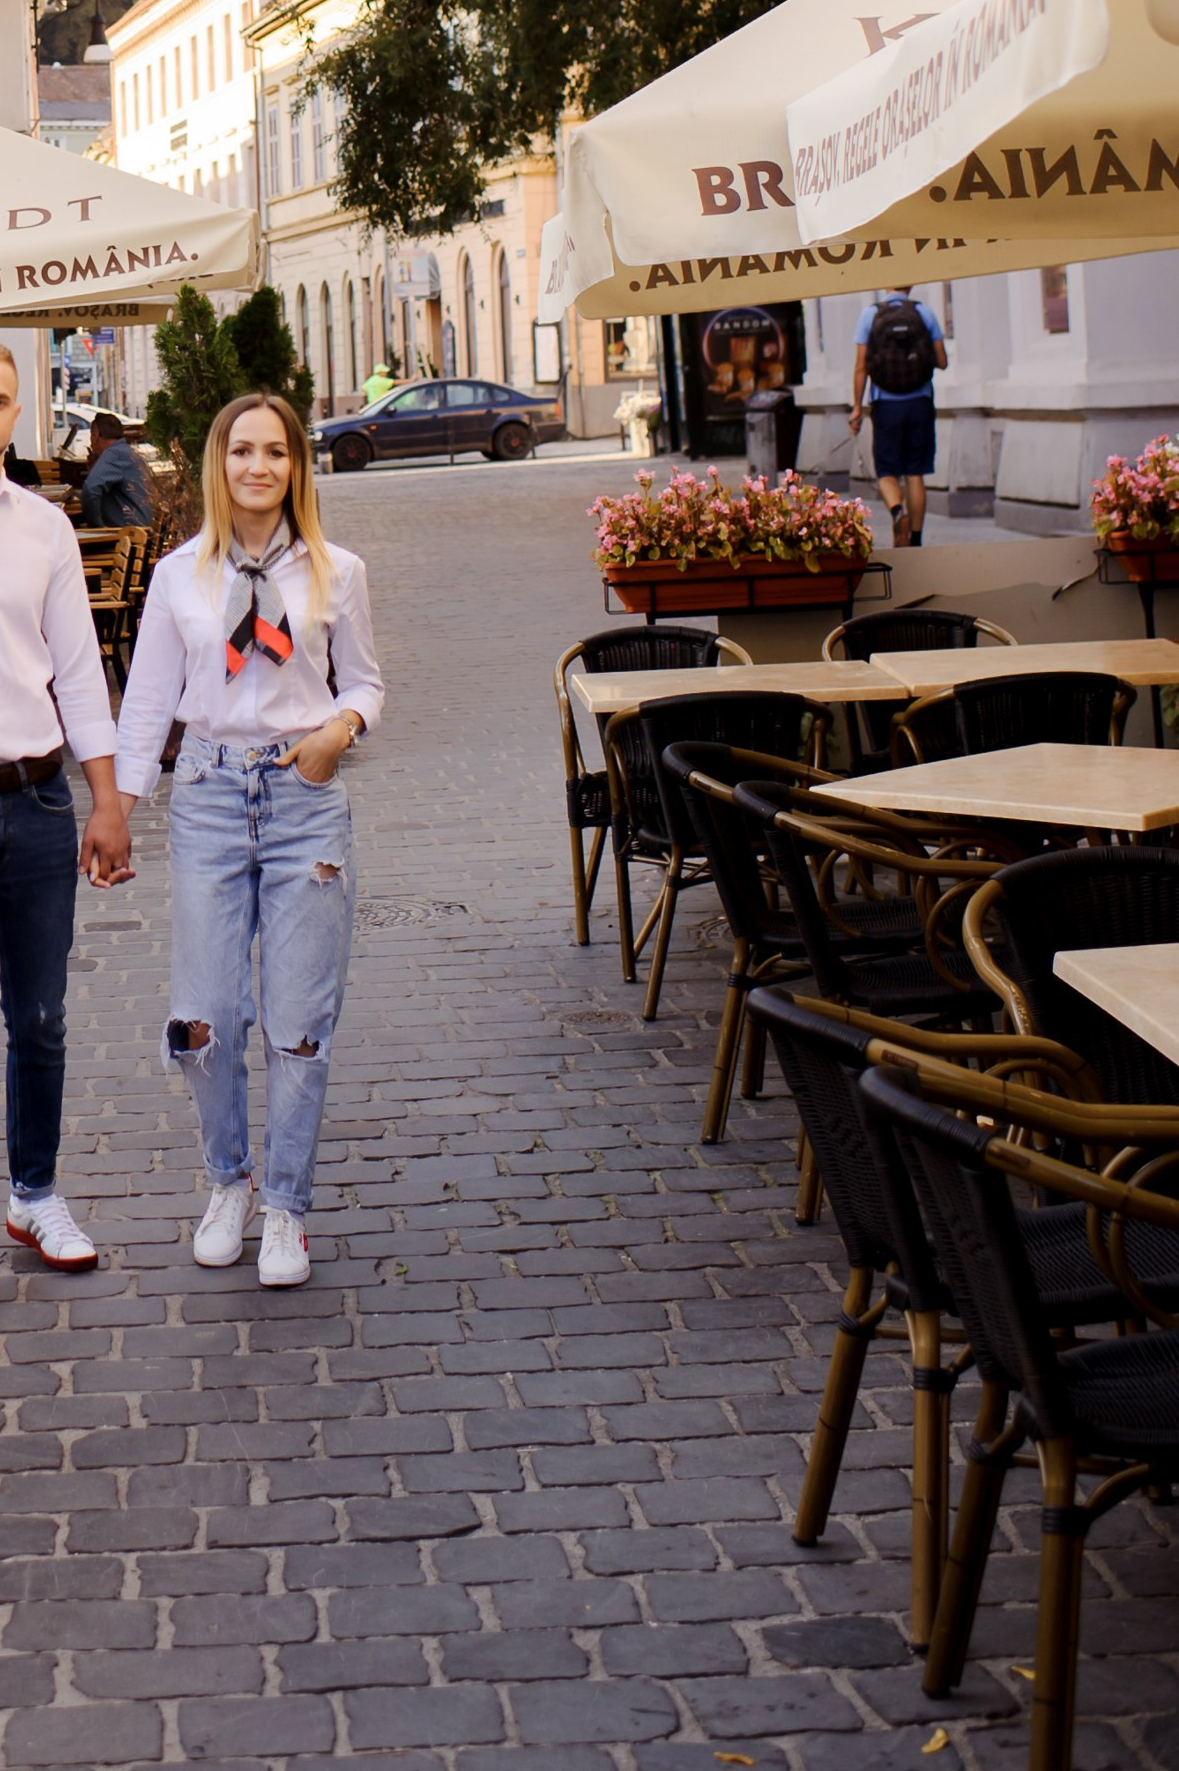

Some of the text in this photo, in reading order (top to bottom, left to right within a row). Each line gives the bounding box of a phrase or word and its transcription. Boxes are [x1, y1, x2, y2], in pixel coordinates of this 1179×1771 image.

[843, 105, 881, 184] REGELE
[691, 160, 795, 216] BR
[16, 241, 199, 290] ROMÂNIA.
